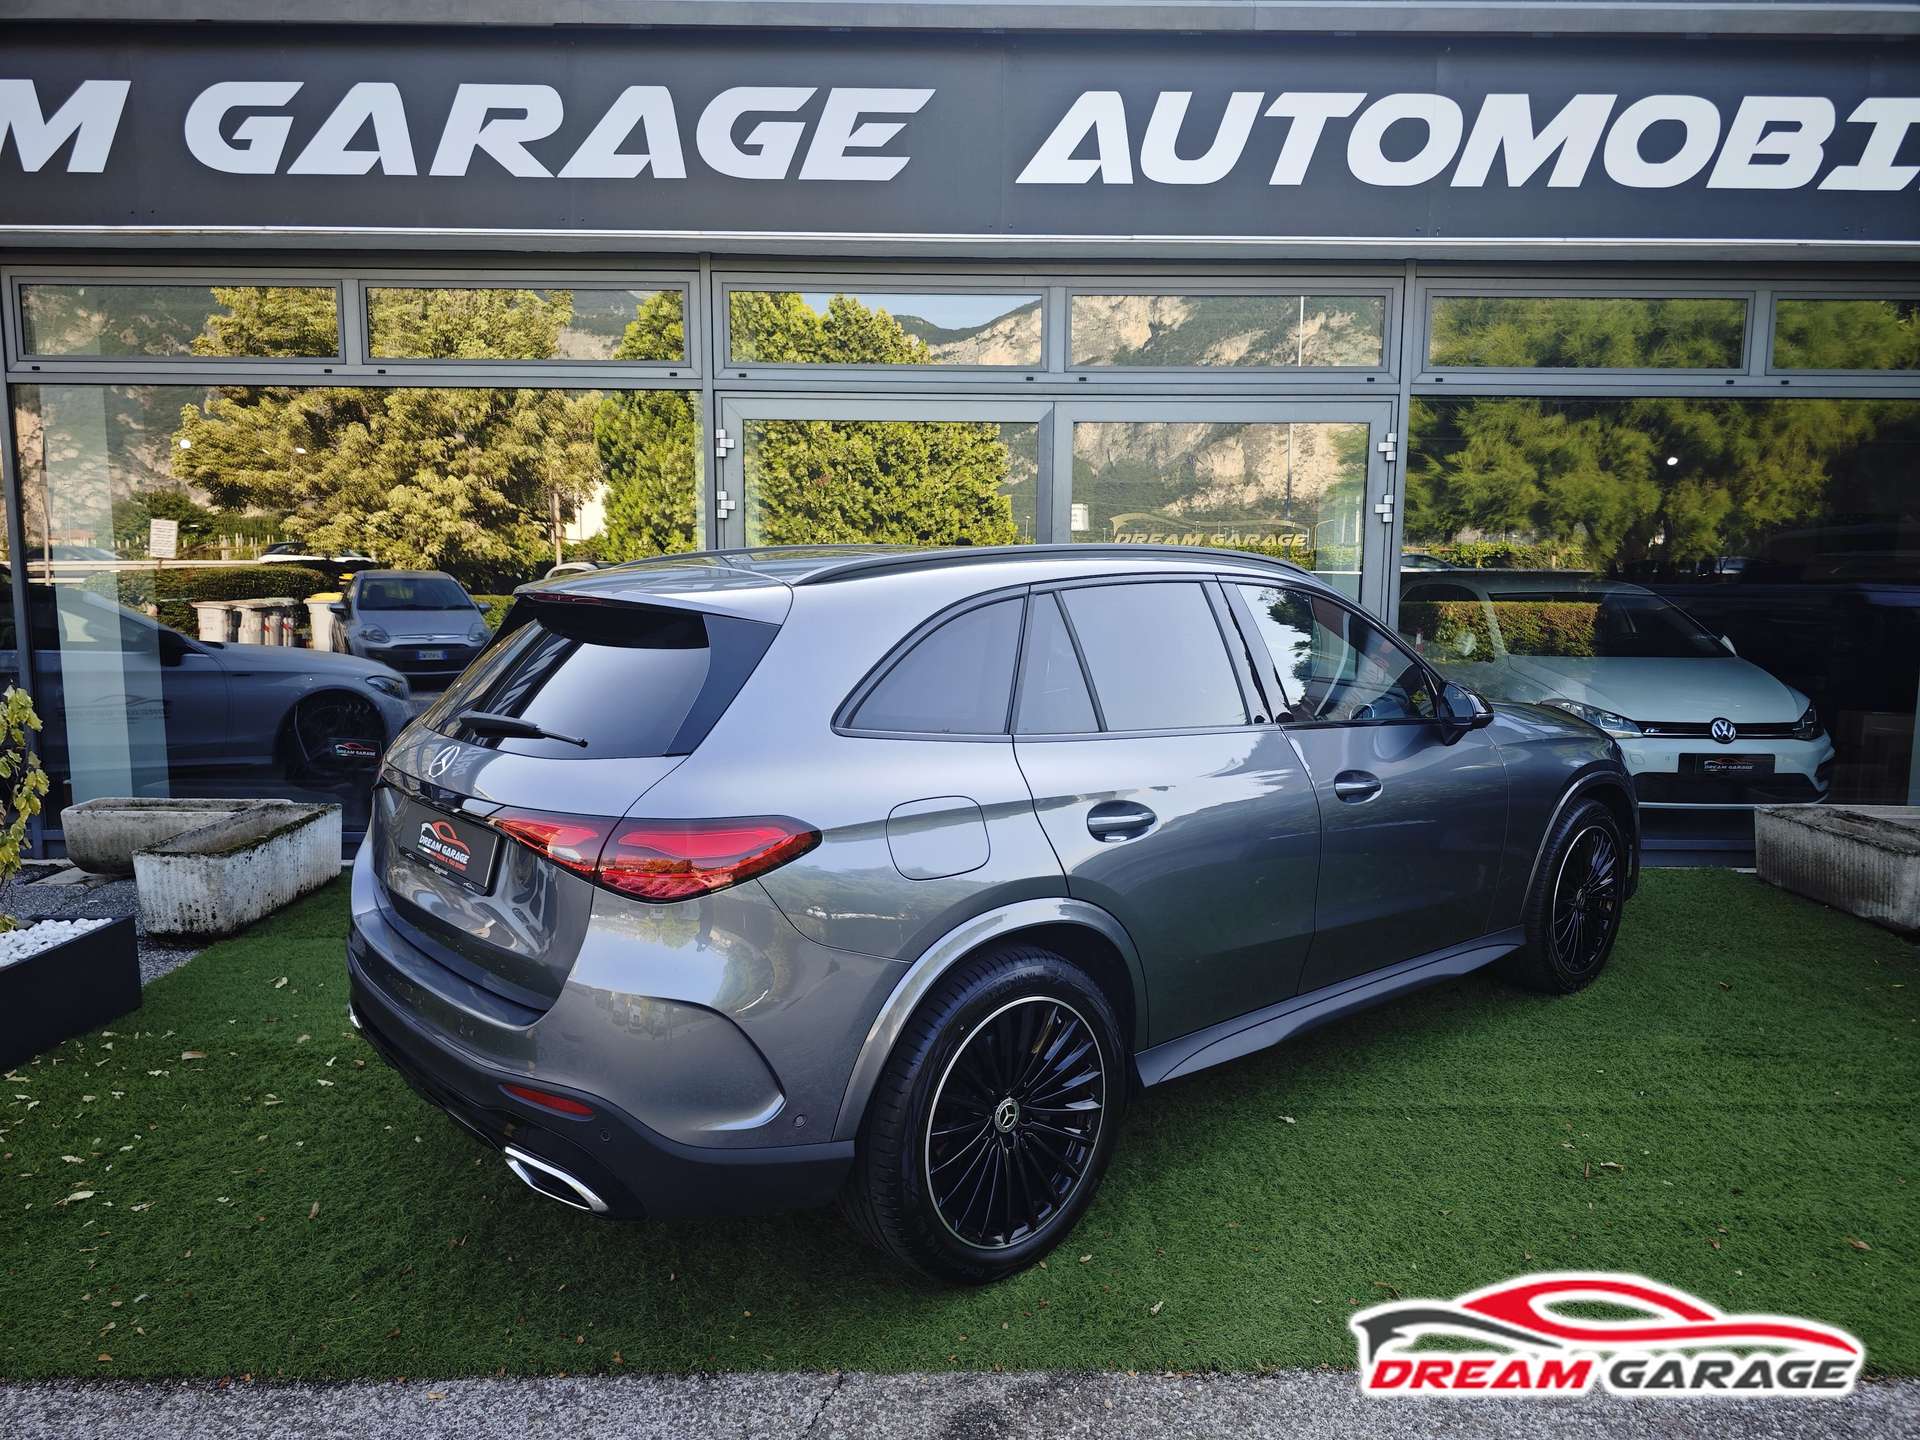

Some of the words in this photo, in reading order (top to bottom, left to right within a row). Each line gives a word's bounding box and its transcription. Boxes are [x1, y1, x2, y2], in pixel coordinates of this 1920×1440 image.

[184, 81, 937, 181] GARAGE
[1114, 533, 1203, 546] DREAM
[1210, 533, 1309, 547] GARAGE
[419, 835, 442, 852] DREAM
[441, 845, 470, 864] GARAGE
